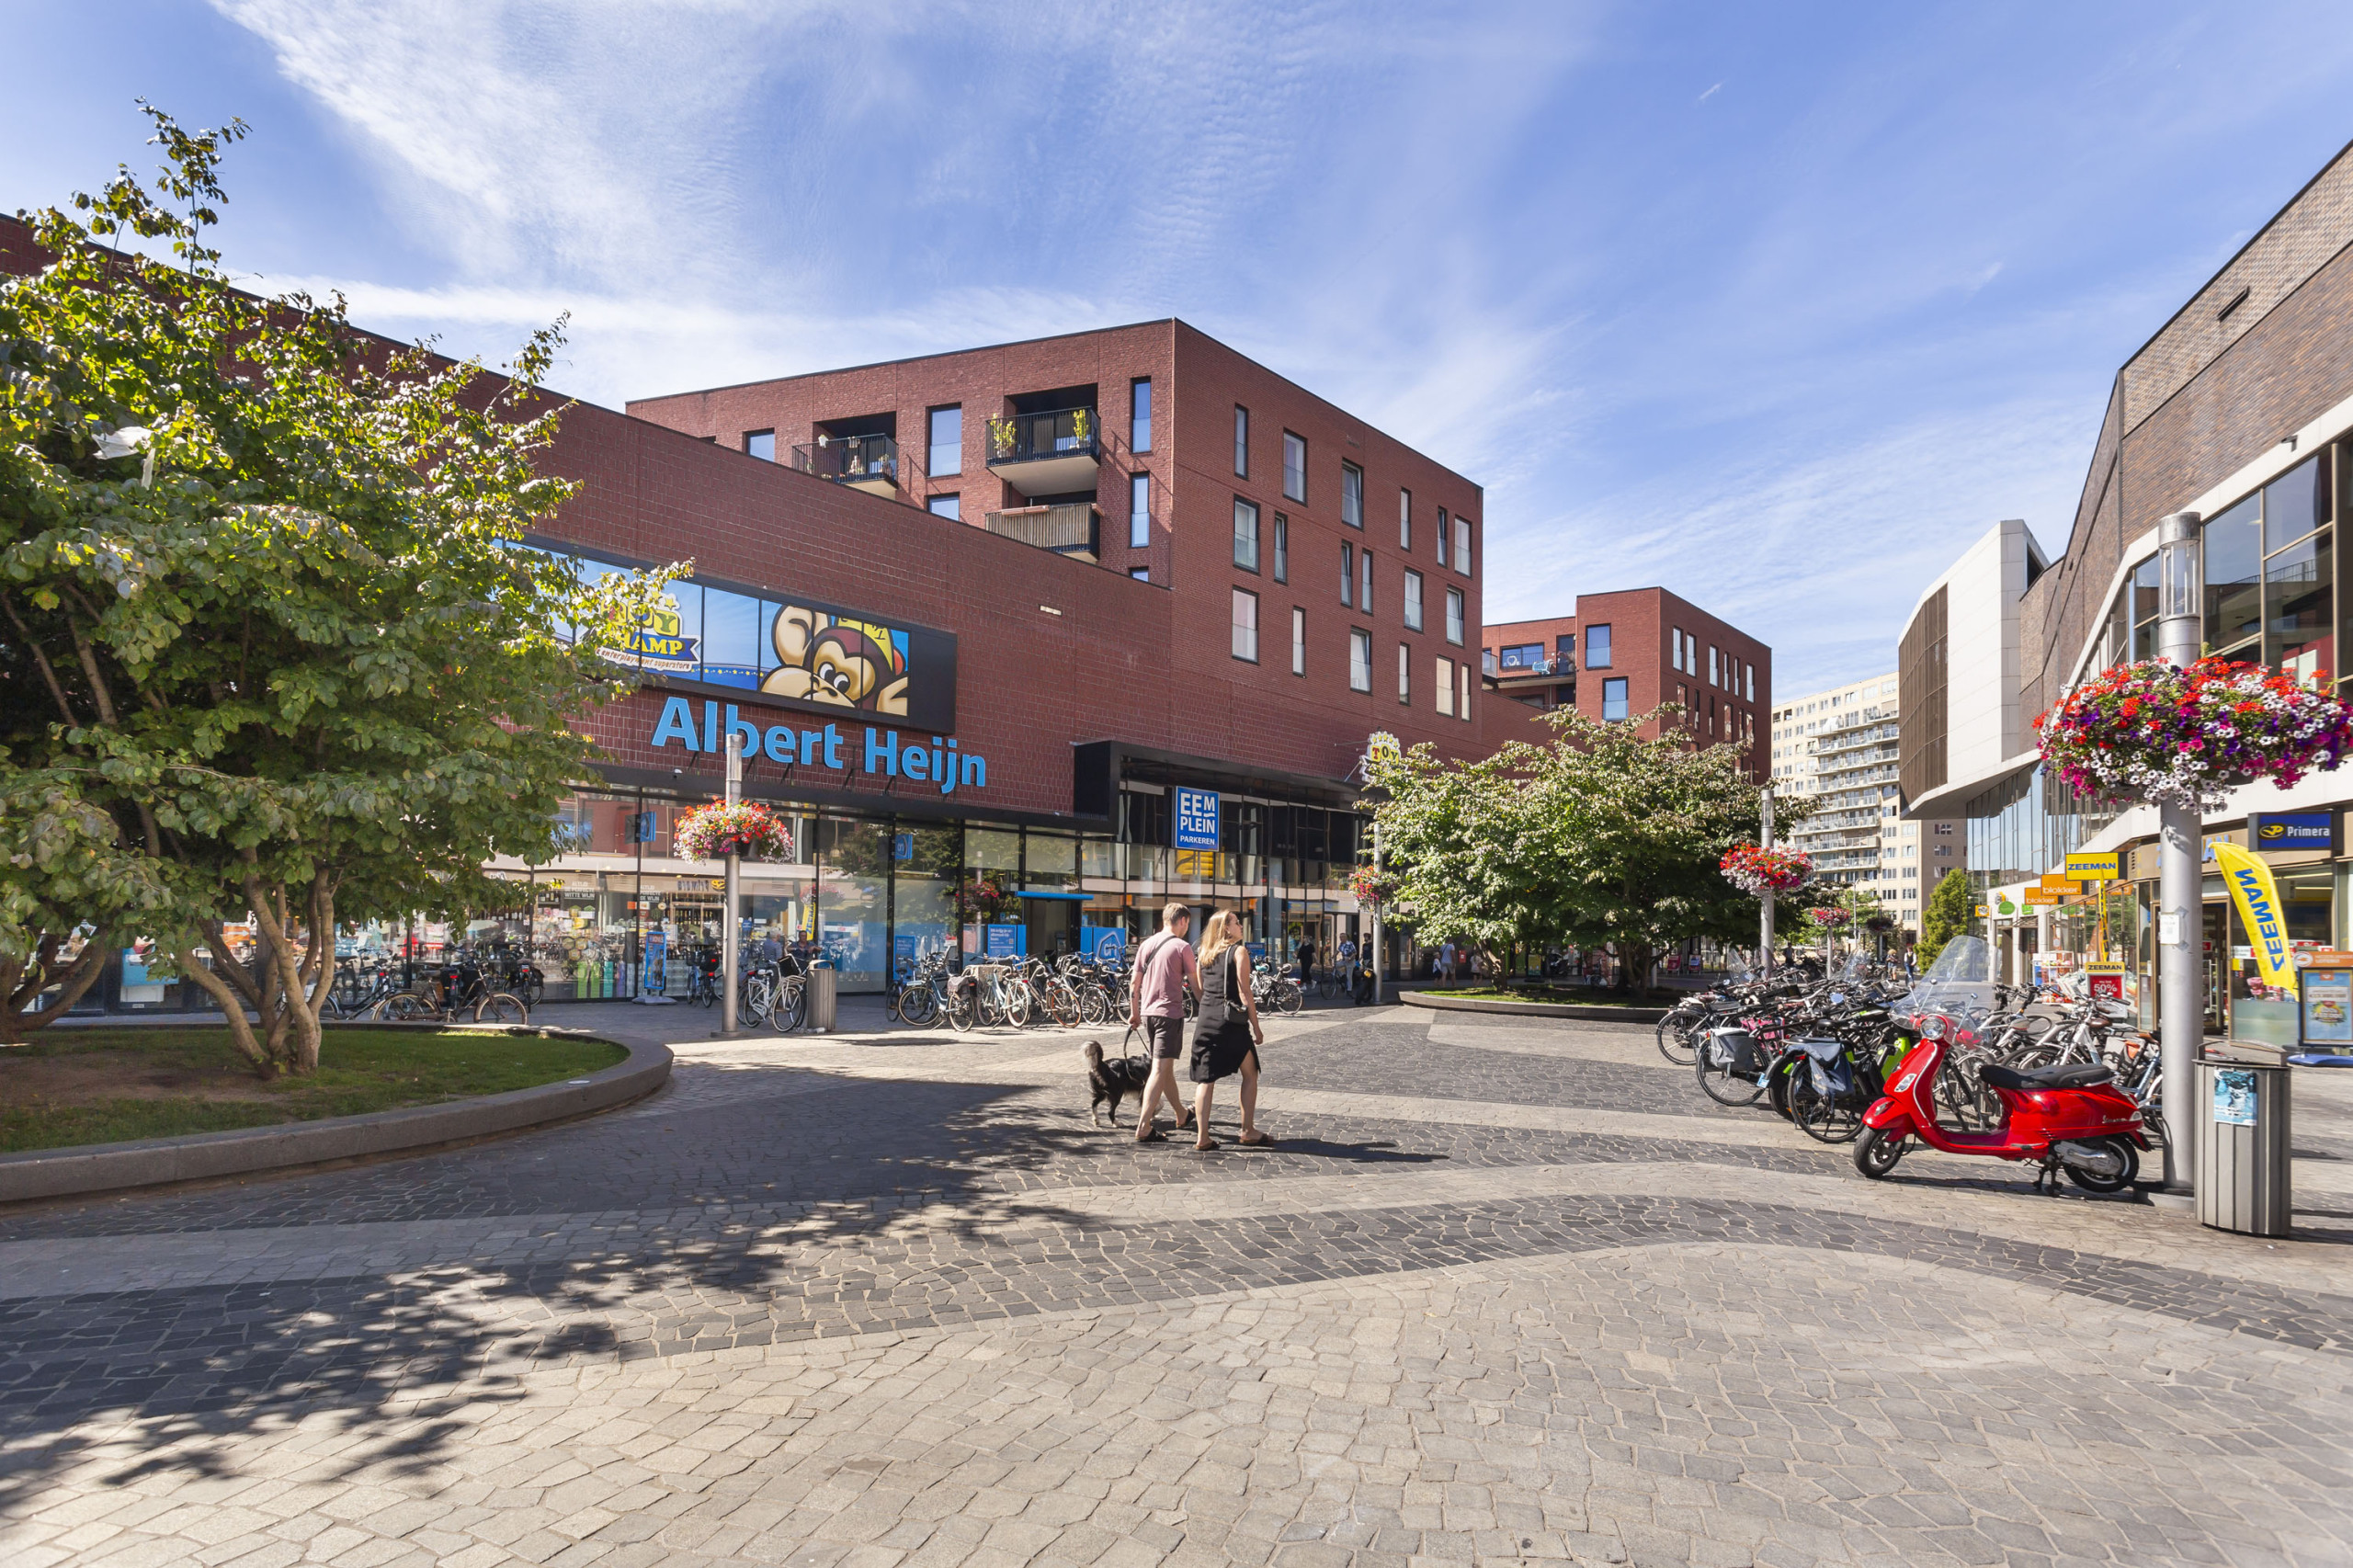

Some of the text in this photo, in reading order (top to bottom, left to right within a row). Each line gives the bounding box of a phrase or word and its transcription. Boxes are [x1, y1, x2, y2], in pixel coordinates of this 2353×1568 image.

[615, 631, 683, 655] HAMP
[654, 659, 690, 670] superstore
[652, 697, 986, 794] Albert Heijn
[1372, 745, 1398, 761] TOY
[1180, 792, 1215, 817] EEM
[1180, 816, 1215, 834] PLEIN
[2288, 826, 2330, 836] Primera
[1180, 835, 1215, 846] PARKEREN
[2067, 862, 2117, 871] ZEEMAN
[2094, 983, 2118, 993] 50%
